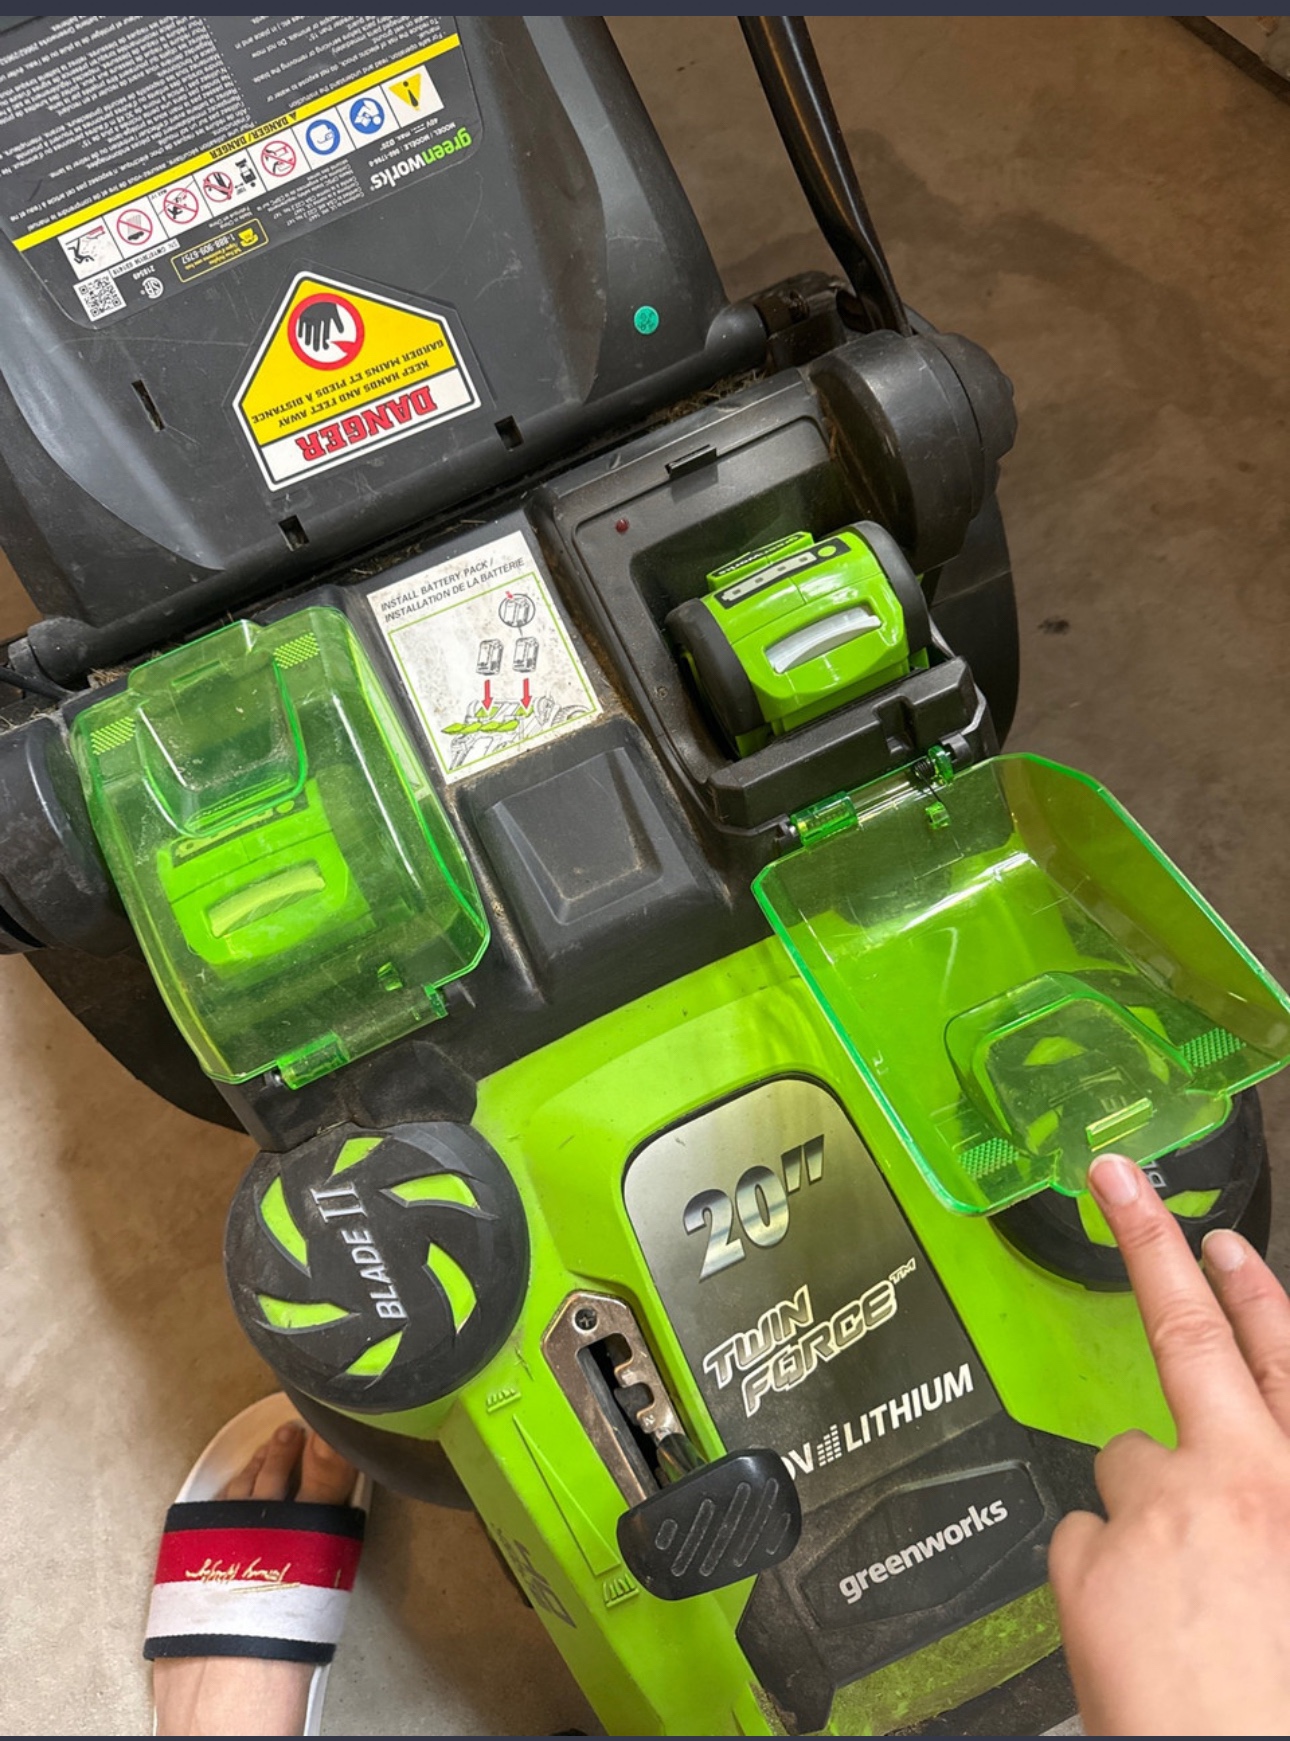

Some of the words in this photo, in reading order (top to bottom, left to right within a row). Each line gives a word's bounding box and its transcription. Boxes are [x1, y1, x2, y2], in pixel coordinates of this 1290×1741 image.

[432, 120, 456, 137] MODEL
[208, 135, 247, 159] DANGER
[371, 127, 472, 191] greenworks
[401, 338, 444, 363] GARDER
[347, 372, 363, 384] ET
[363, 356, 400, 378] MAINS
[400, 359, 429, 377] KEEP
[314, 378, 347, 398] PIEDS
[362, 371, 400, 392] HANDS
[308, 397, 337, 415] FEET
[337, 386, 362, 402] AND
[250, 396, 304, 424] DISTANCE
[276, 408, 308, 428] AWAY
[294, 385, 438, 462] DANGER
[380, 590, 418, 612] INSTALL
[420, 572, 461, 595] BATTERY
[464, 560, 489, 577] PACK
[385, 588, 451, 622] INSTALLATION
[452, 583, 465, 595] DE
[466, 576, 480, 589] LA
[481, 557, 525, 583] BATTERIE
[341, 1229, 408, 1319] BLADE
[703, 1284, 814, 1390] TWIN
[842, 1363, 974, 1453] LITHIUM
[838, 1499, 1009, 1605] greenworks
